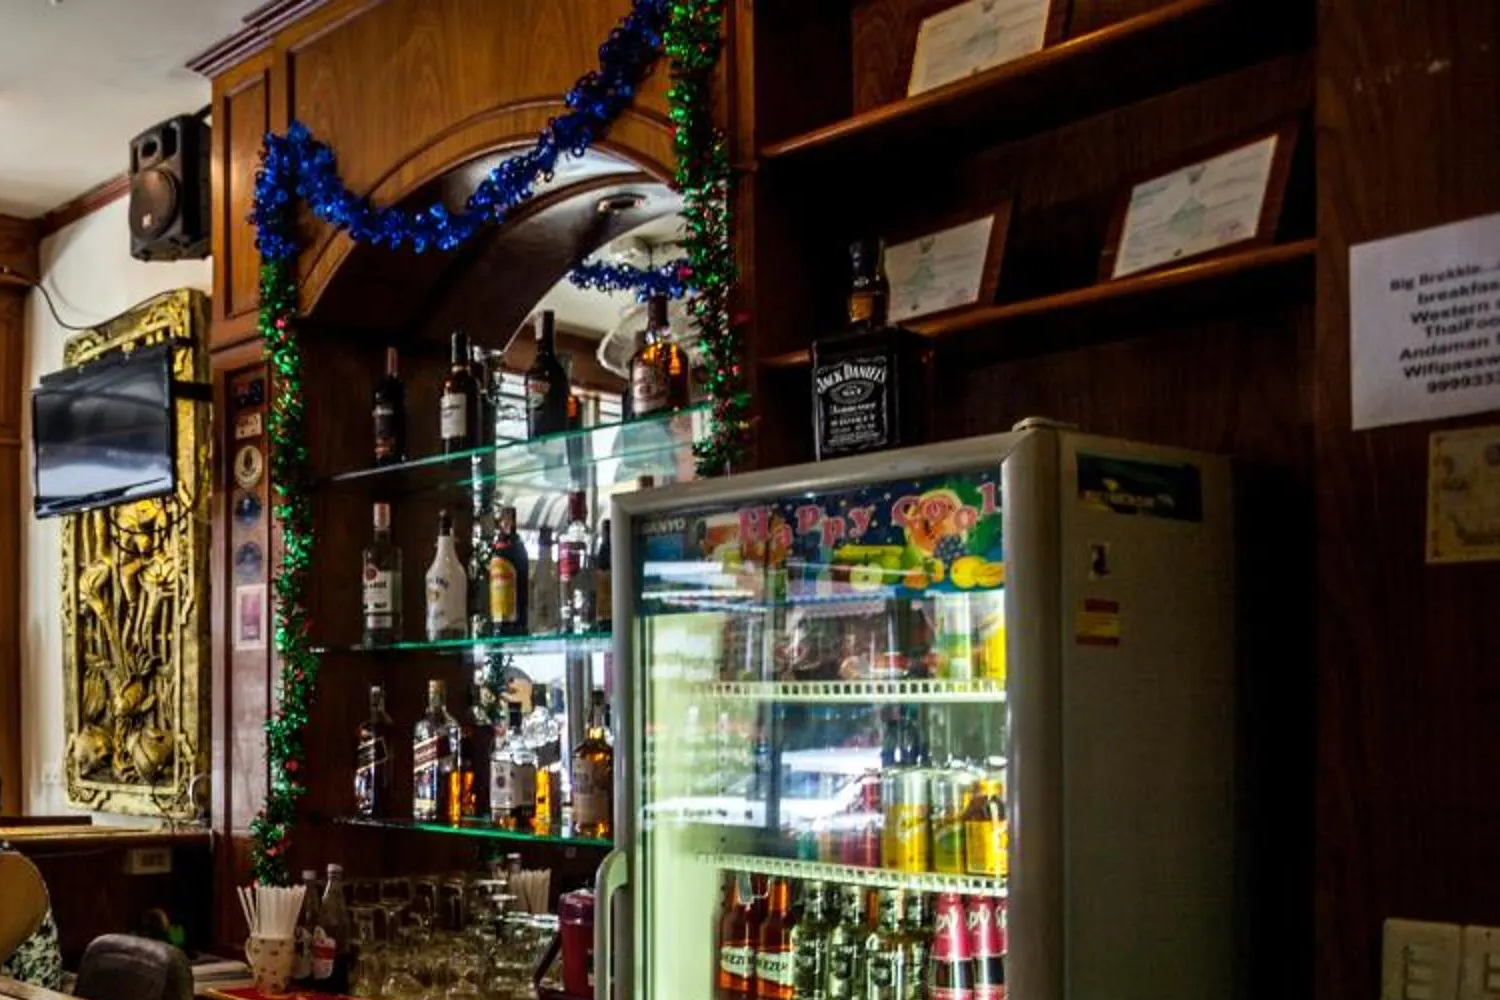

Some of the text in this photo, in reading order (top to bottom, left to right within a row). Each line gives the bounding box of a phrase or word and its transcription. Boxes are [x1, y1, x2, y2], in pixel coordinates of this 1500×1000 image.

[1411, 301, 1490, 324] Western
[1399, 337, 1489, 362] Andaman
[737, 481, 999, 550] Happy Cool
